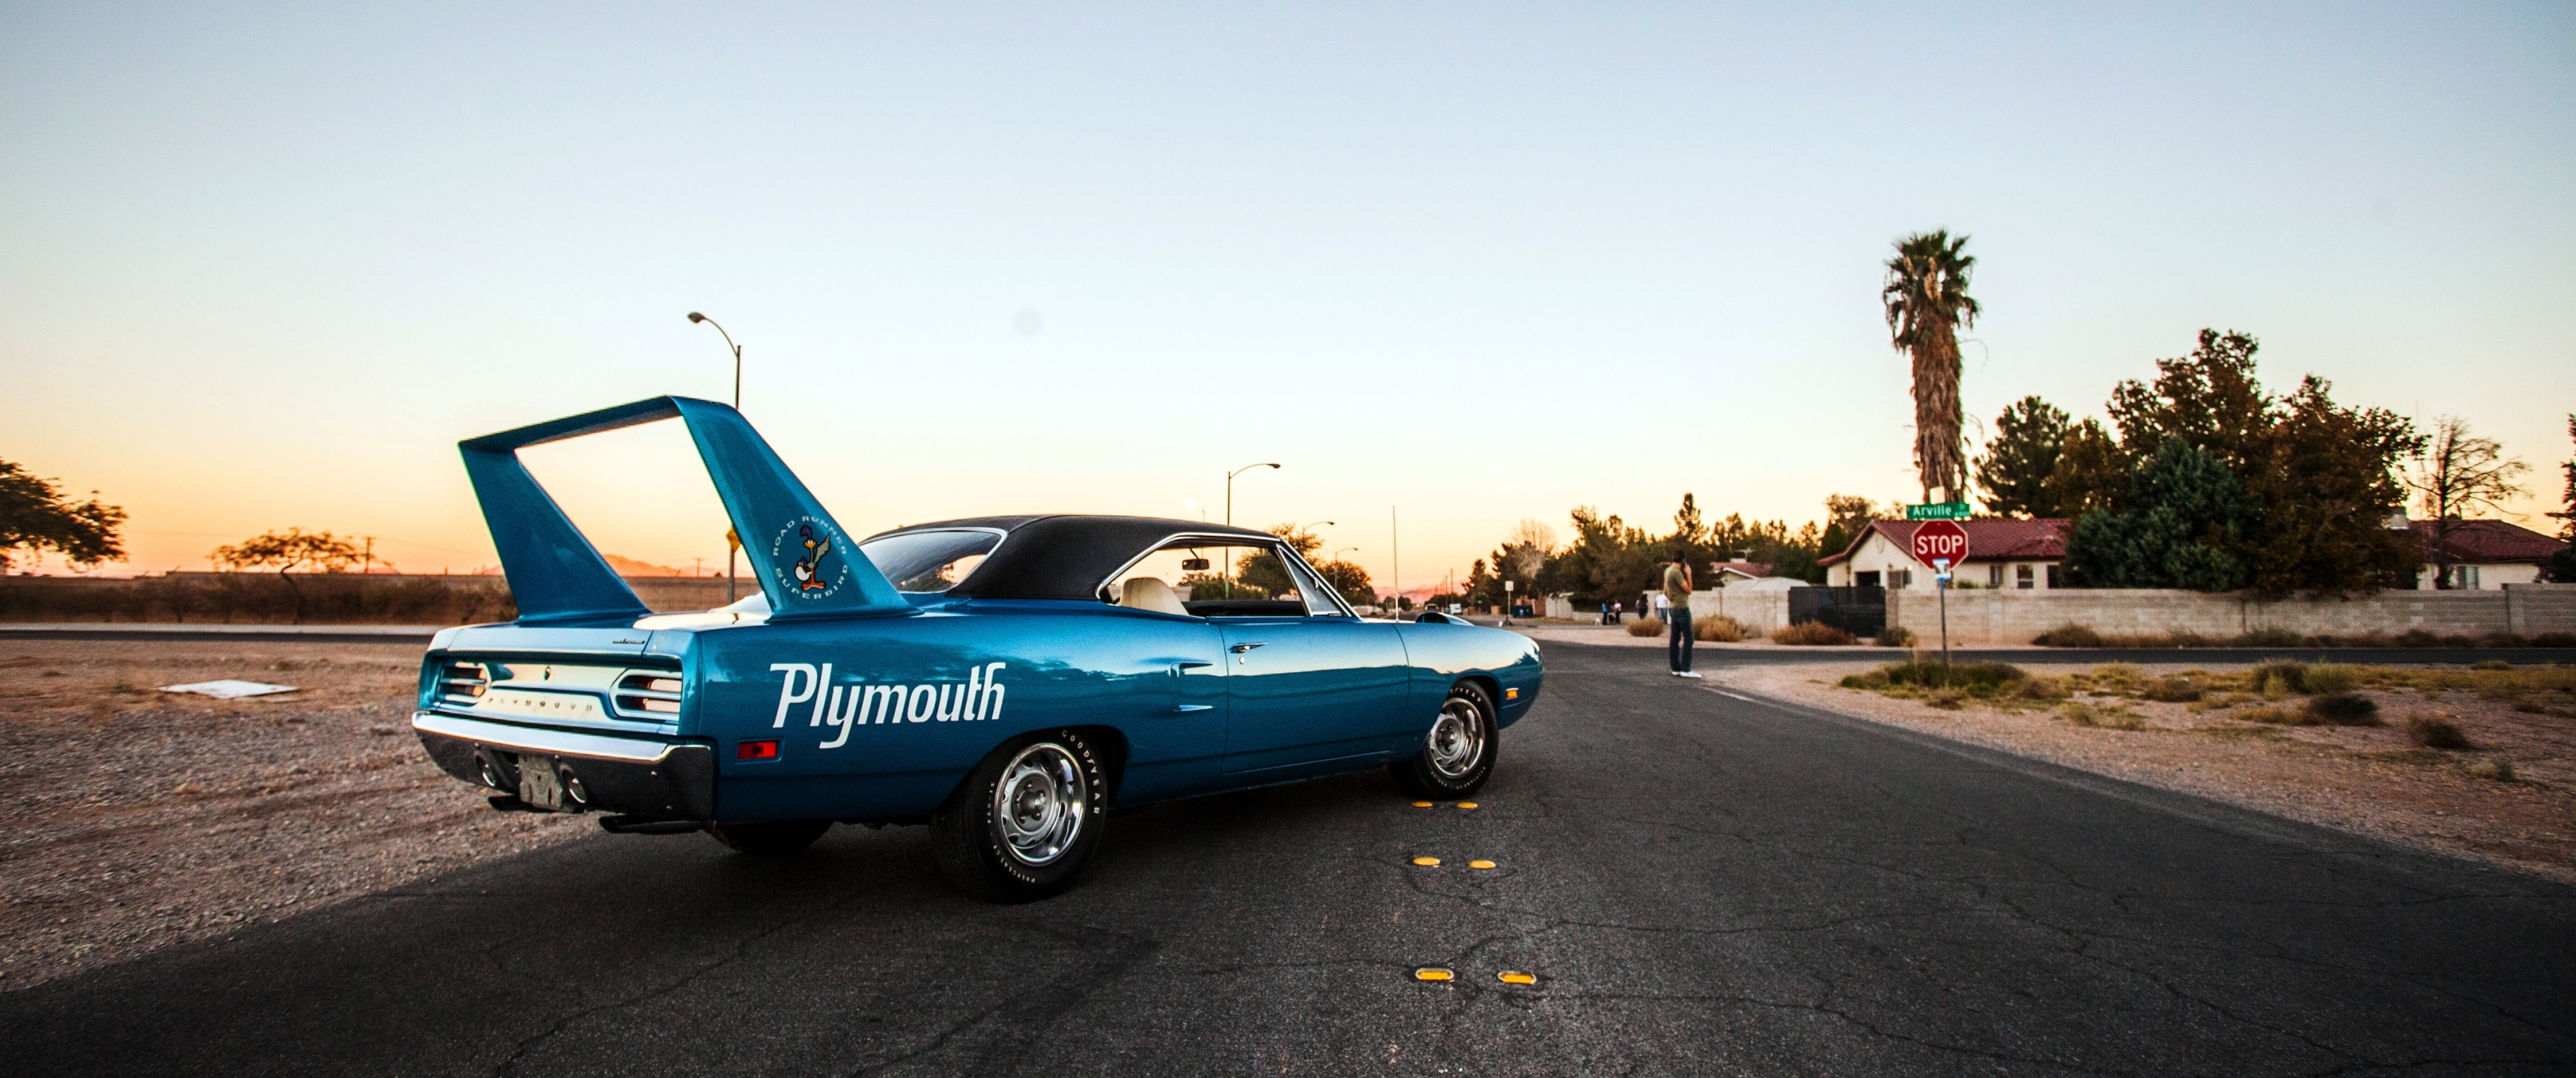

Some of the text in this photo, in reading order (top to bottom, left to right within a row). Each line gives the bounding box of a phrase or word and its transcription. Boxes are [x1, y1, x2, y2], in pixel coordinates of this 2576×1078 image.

[1913, 505, 1952, 517] Arville
[773, 516, 847, 556] ROAD RUNNER
[1916, 535, 1963, 555] STOP
[775, 564, 848, 600] SUPERBIRD
[769, 662, 1006, 749] Plymouth
[1062, 730, 1101, 814] GOODYEAR
